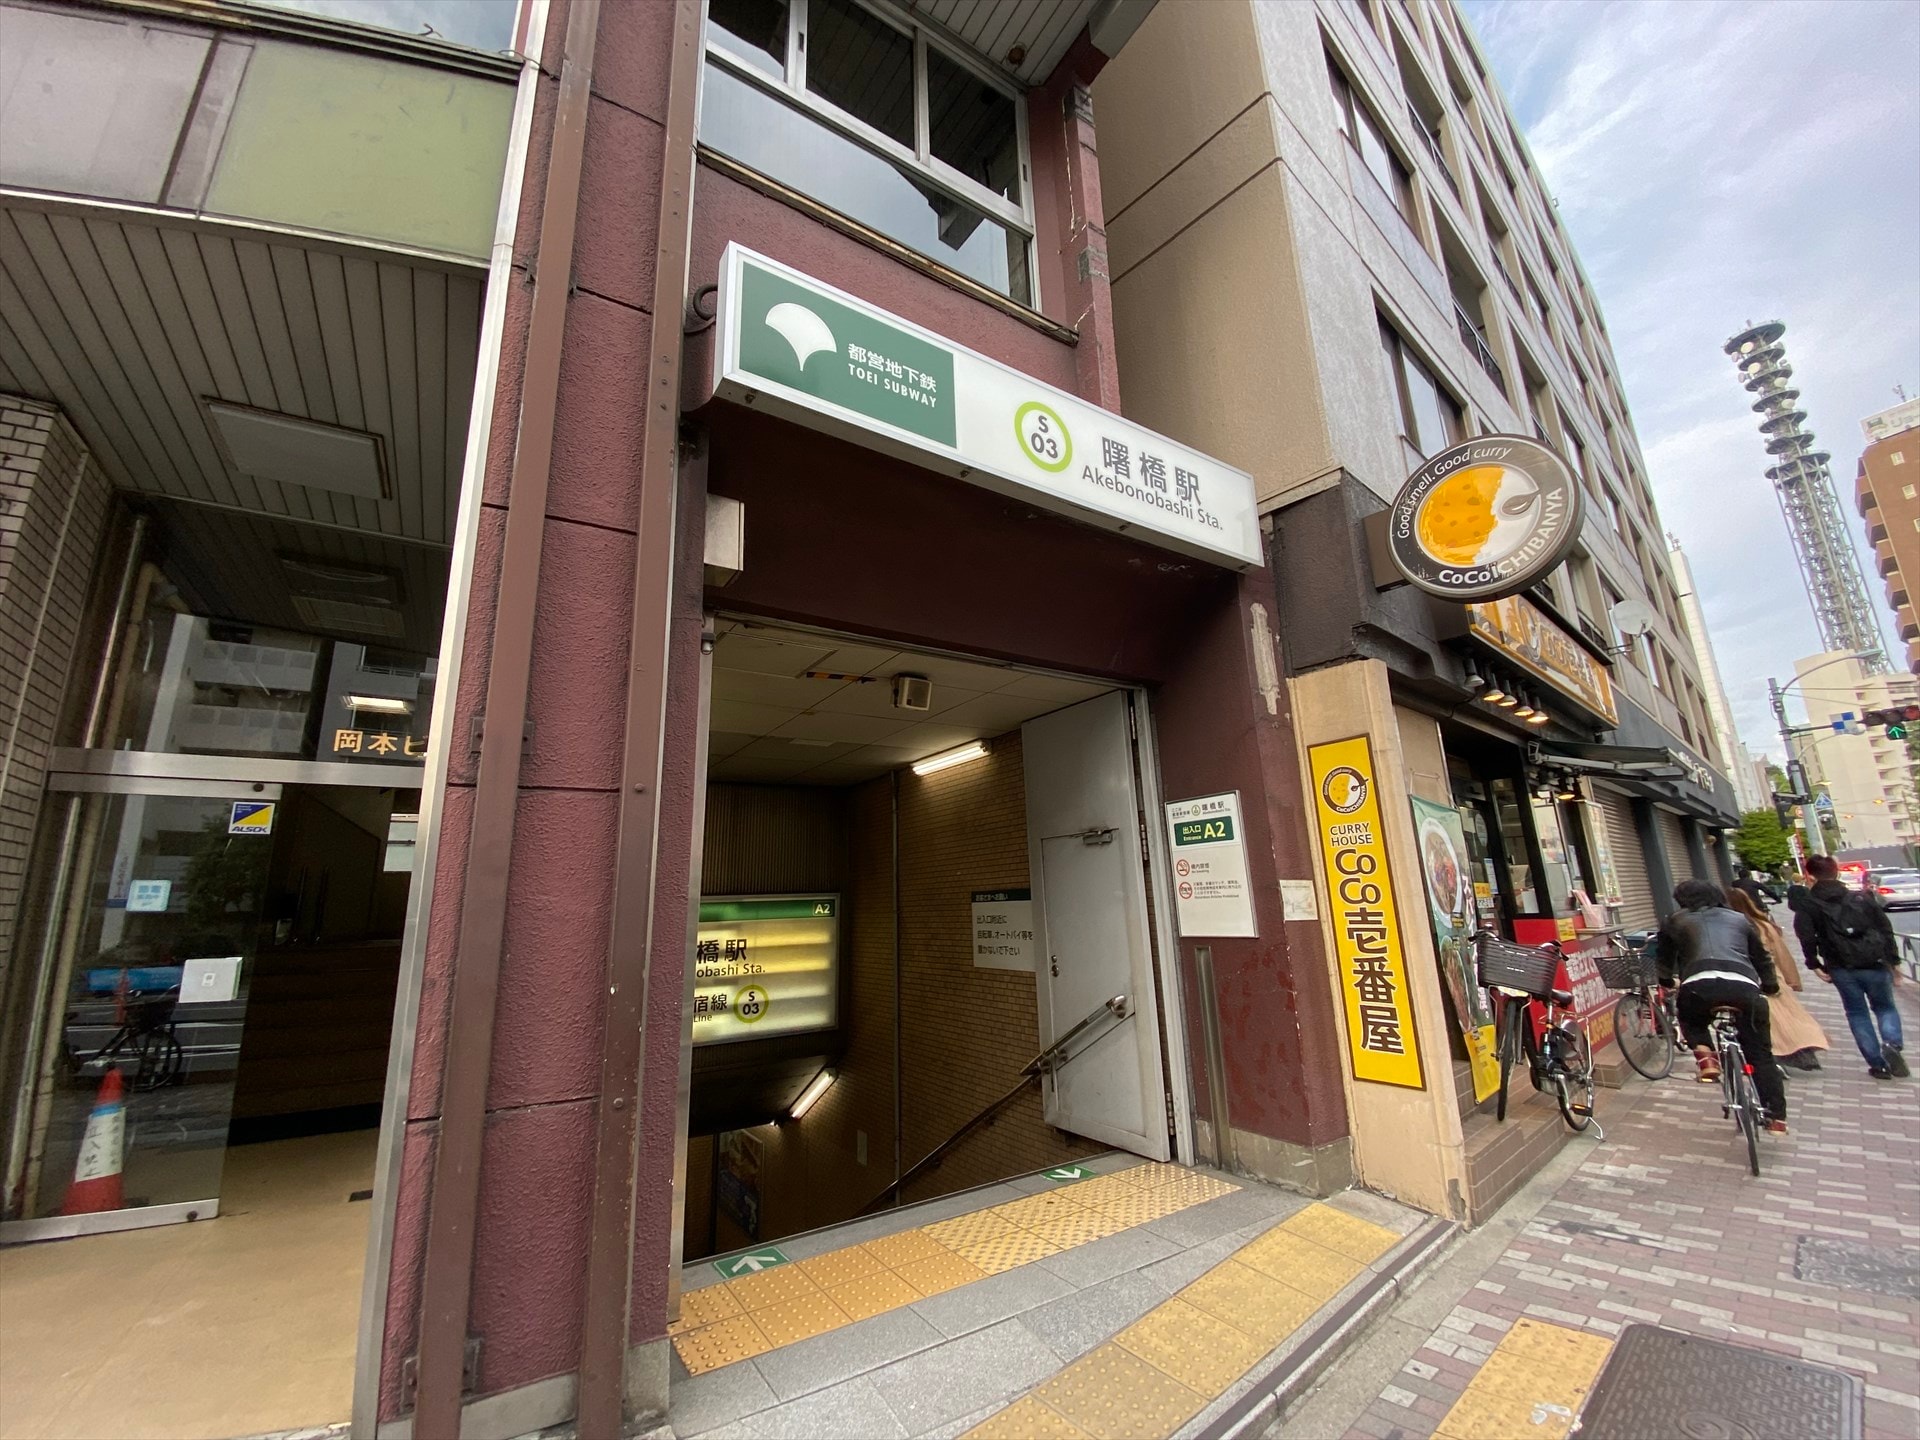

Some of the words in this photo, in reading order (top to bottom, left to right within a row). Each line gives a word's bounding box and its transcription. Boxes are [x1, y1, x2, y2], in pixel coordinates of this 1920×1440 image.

[847, 343, 937, 393] 都営地下鉄
[848, 363, 878, 385] TOEI
[884, 378, 937, 408] SUBWAY
[1038, 415, 1049, 433] S
[1031, 432, 1058, 459] 03
[1102, 437, 1202, 506] 曙橋駅
[1082, 465, 1194, 520] Akebonobashi
[1198, 508, 1224, 531] Sta.
[1397, 506, 1412, 539] Good
[1408, 472, 1436, 506] smell.
[1434, 447, 1471, 475] Good
[1473, 446, 1513, 460] curry
[1182, 825, 1201, 834] 出入口
[1204, 821, 1226, 839] A2
[1330, 822, 1369, 836] CURRY
[1331, 834, 1372, 847] HOUSE
[815, 903, 830, 914] A2
[696, 939, 747, 964] 橋駅
[743, 962, 766, 975] Sta.
[748, 991, 755, 1001] S
[742, 1003, 760, 1015] 03
